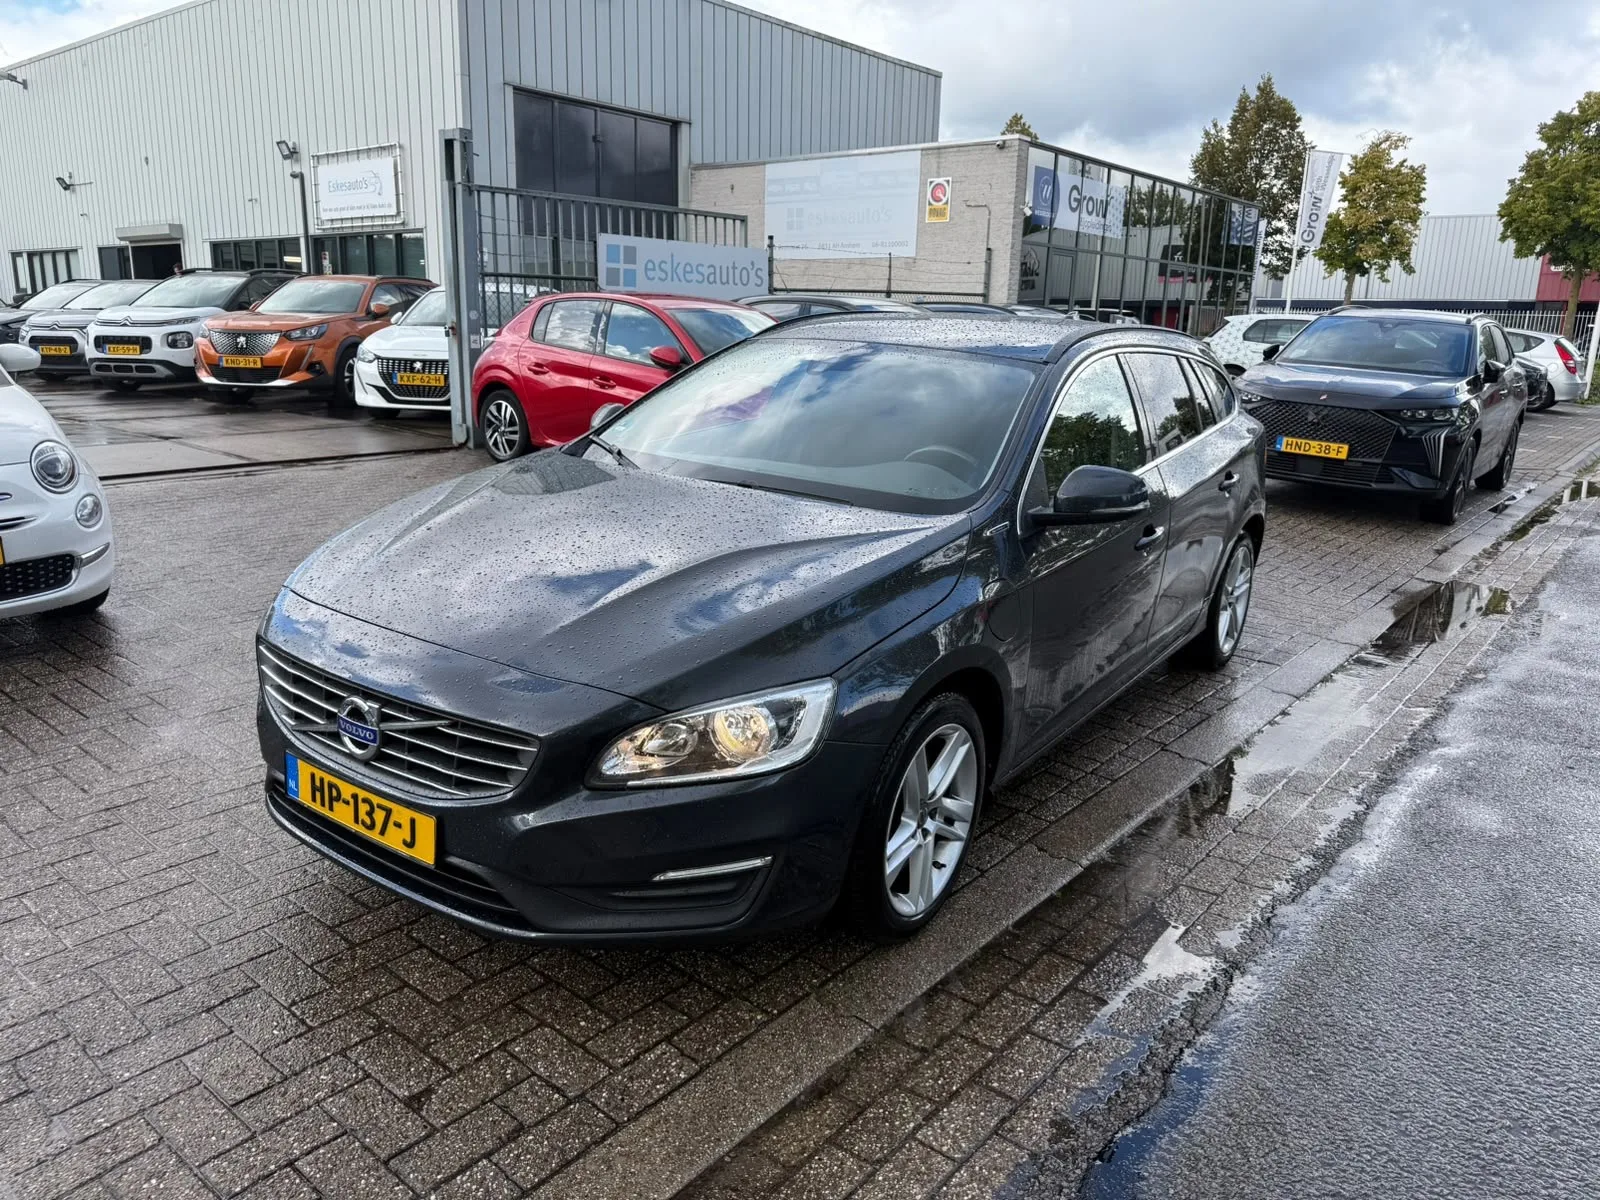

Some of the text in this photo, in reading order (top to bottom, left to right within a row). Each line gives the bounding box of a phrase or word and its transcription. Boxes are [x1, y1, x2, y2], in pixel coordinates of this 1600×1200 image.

[328, 177, 368, 193] Eskesauto's
[1301, 195, 1322, 243] Grow
[644, 252, 764, 288] eskesauto's
[224, 357, 258, 367] KND-31-R
[399, 374, 441, 385] KXF-62-H
[1284, 439, 1344, 457] HND-38-F
[339, 719, 376, 741] VOLVO
[288, 771, 416, 849] NL HP-137-J
